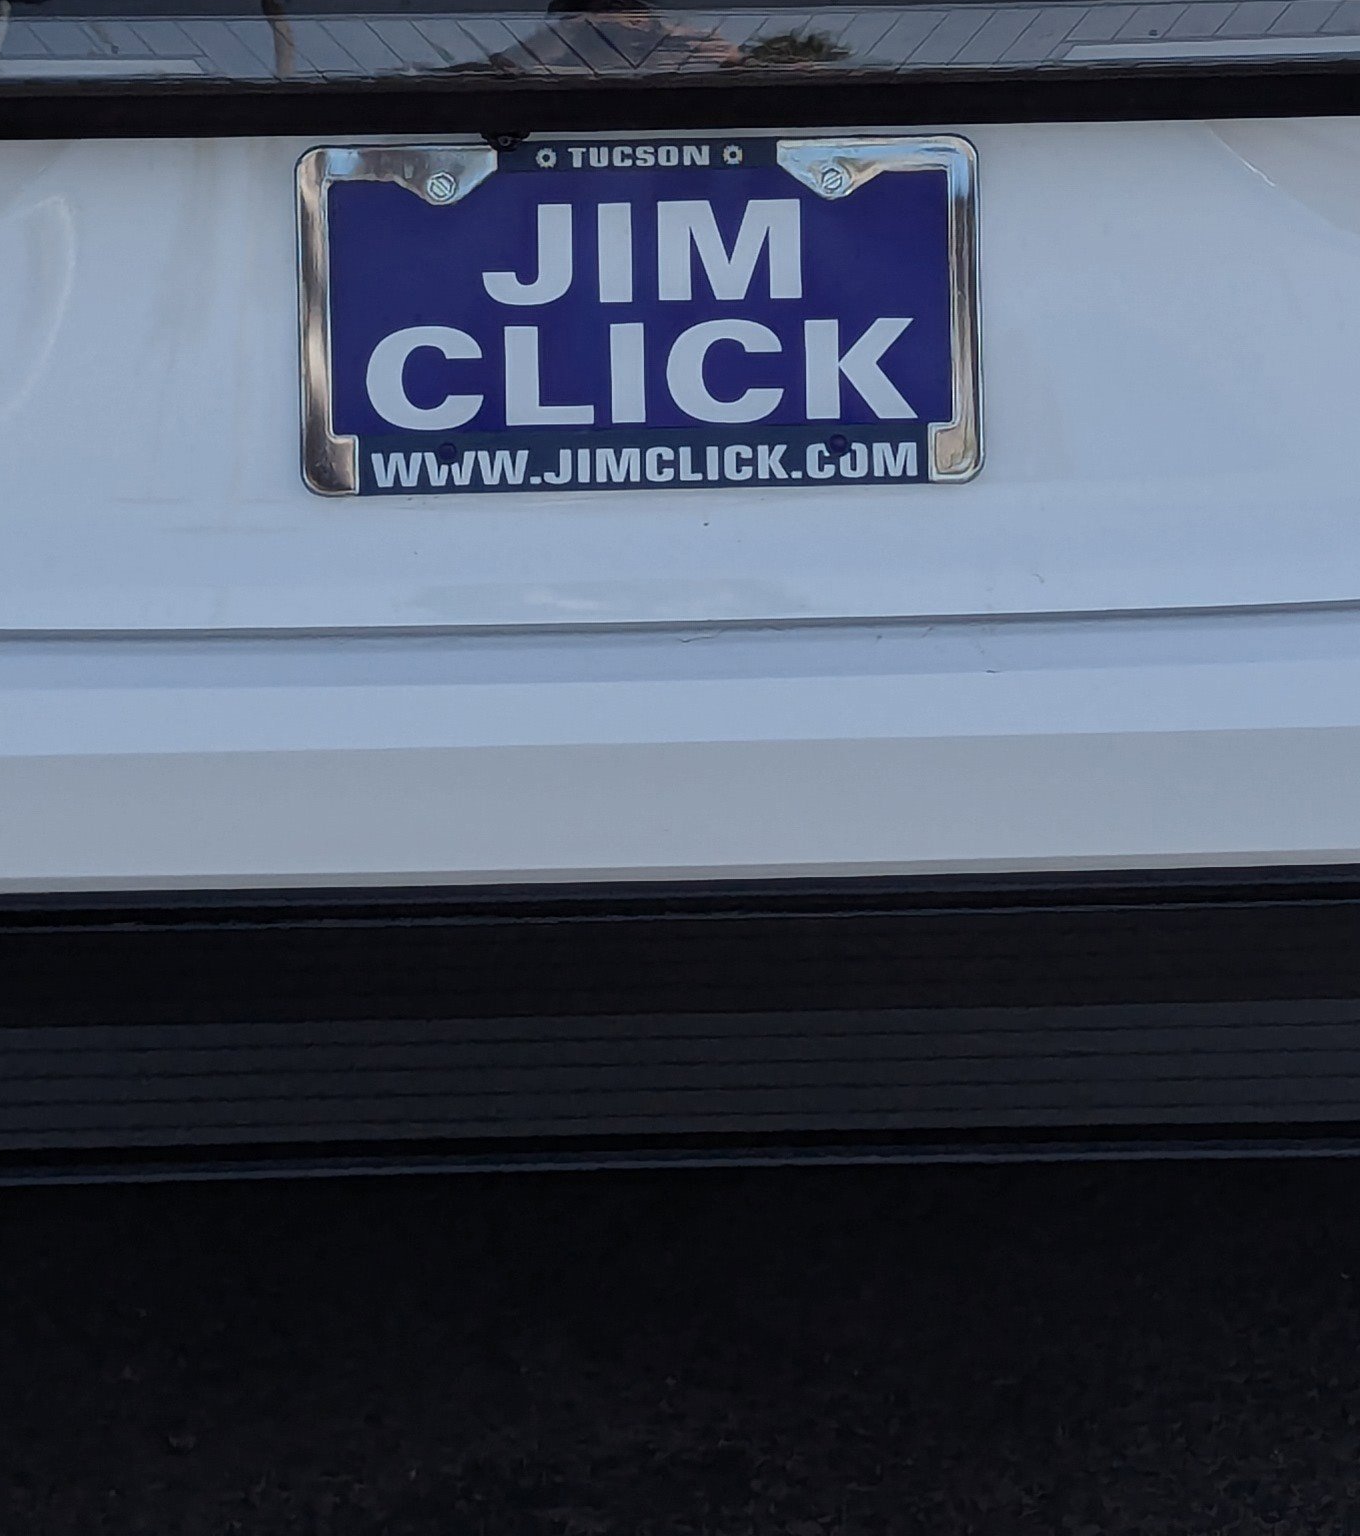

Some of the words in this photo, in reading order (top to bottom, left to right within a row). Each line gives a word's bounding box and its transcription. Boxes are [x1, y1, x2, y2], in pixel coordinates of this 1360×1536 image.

[568, 145, 711, 168] TUCSON
[482, 198, 803, 306] JIM
[365, 317, 919, 431] CLICK
[370, 441, 919, 488] WWW.JIMCLICK.COM
